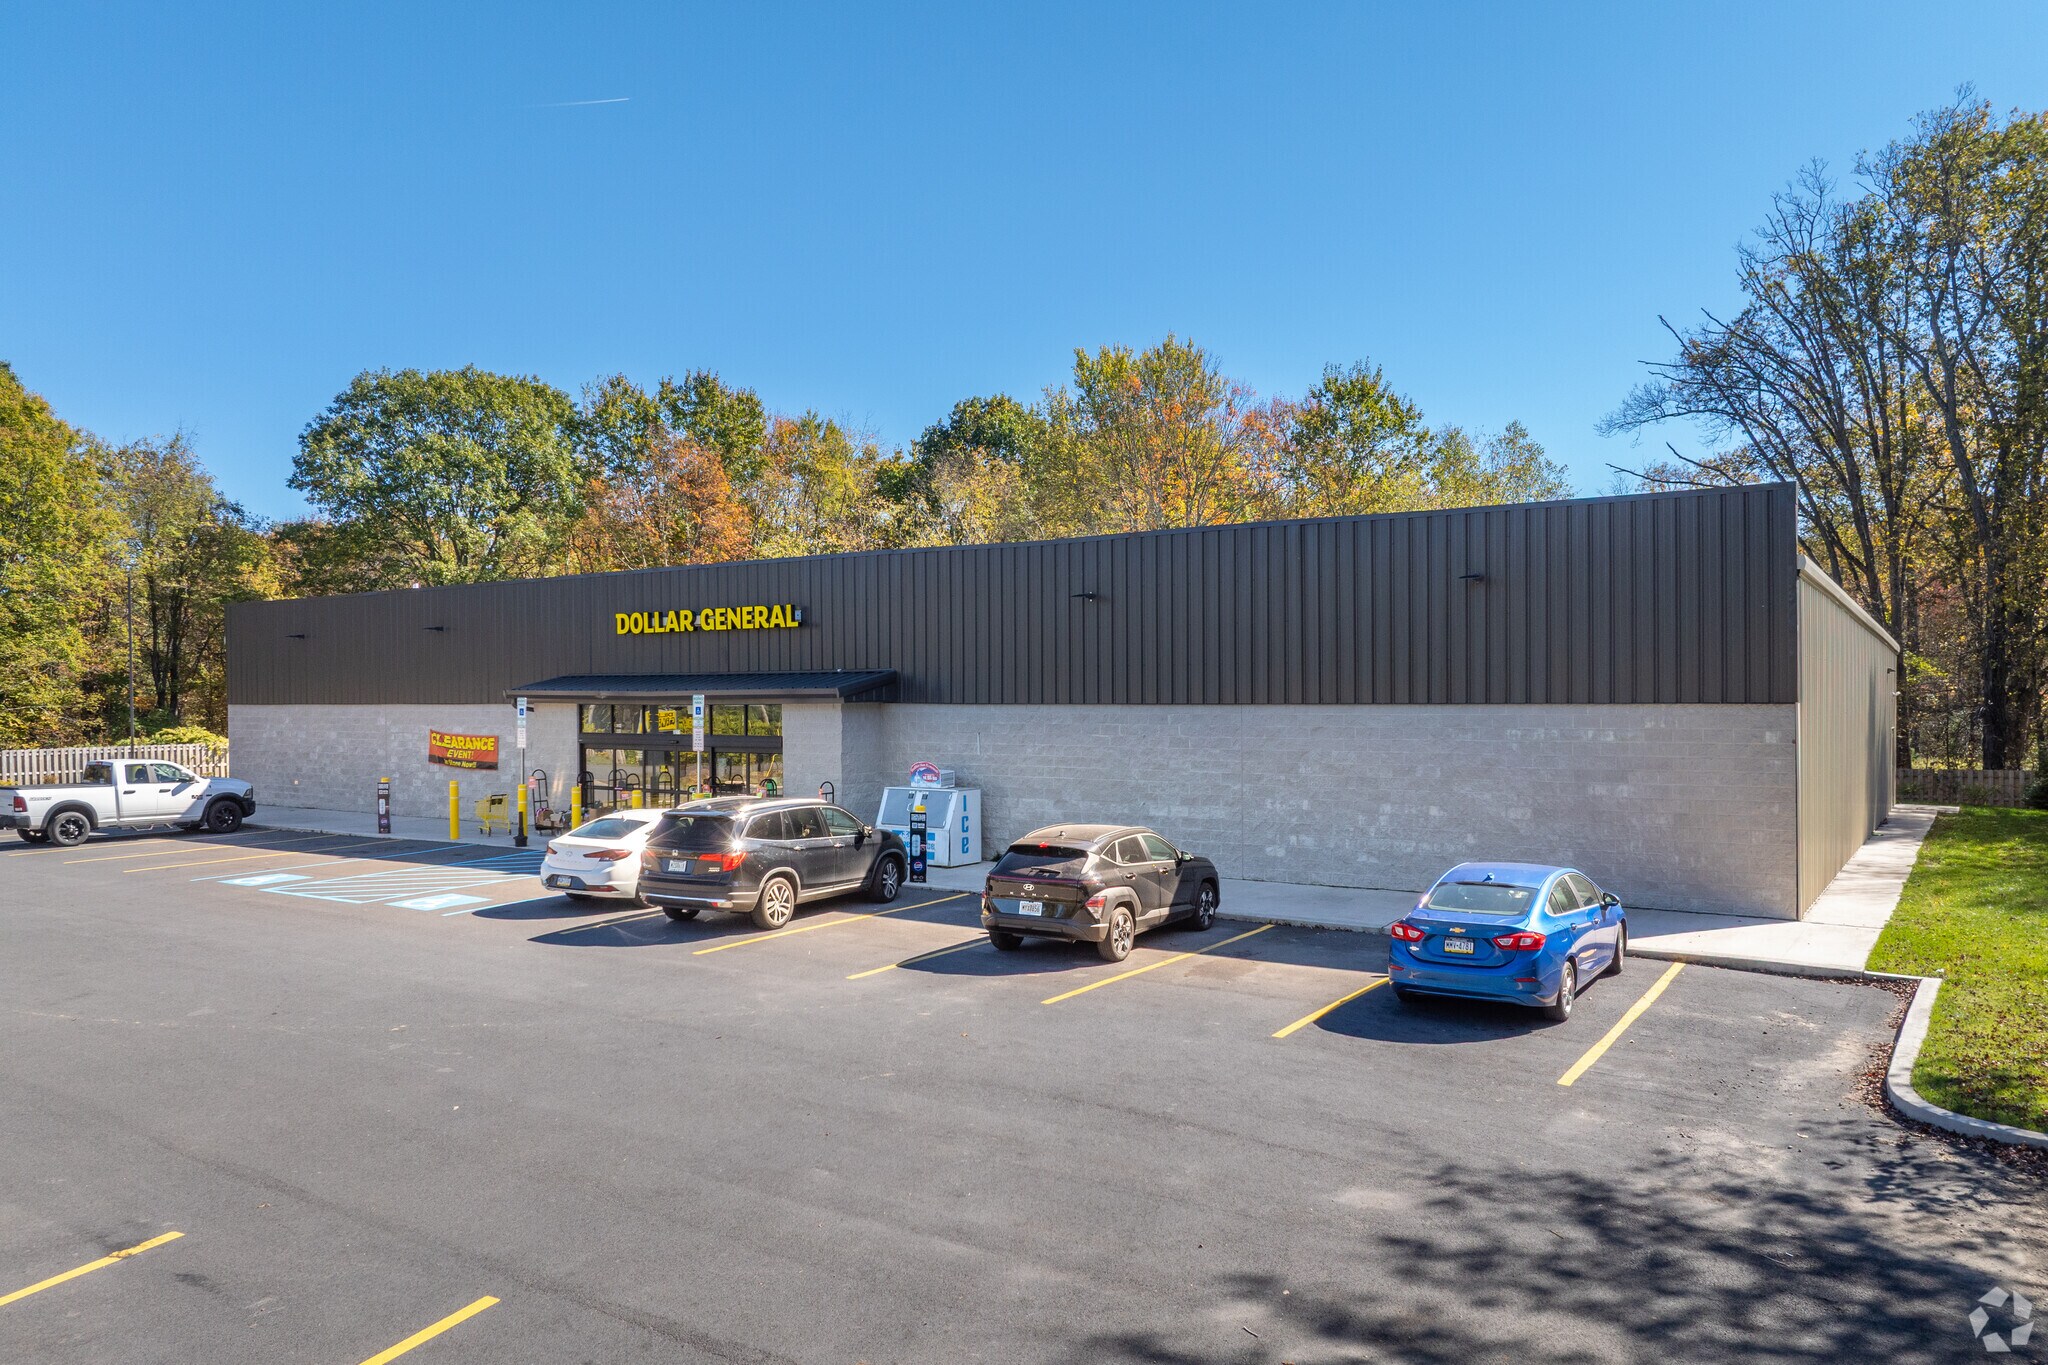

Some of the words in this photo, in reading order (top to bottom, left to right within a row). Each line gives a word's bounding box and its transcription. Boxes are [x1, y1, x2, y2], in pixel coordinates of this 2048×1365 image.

[615, 609, 694, 635] DOLLAR
[700, 604, 799, 631] GENERAL
[431, 732, 495, 751] CLEARANCE
[447, 749, 475, 760] EVENT!
